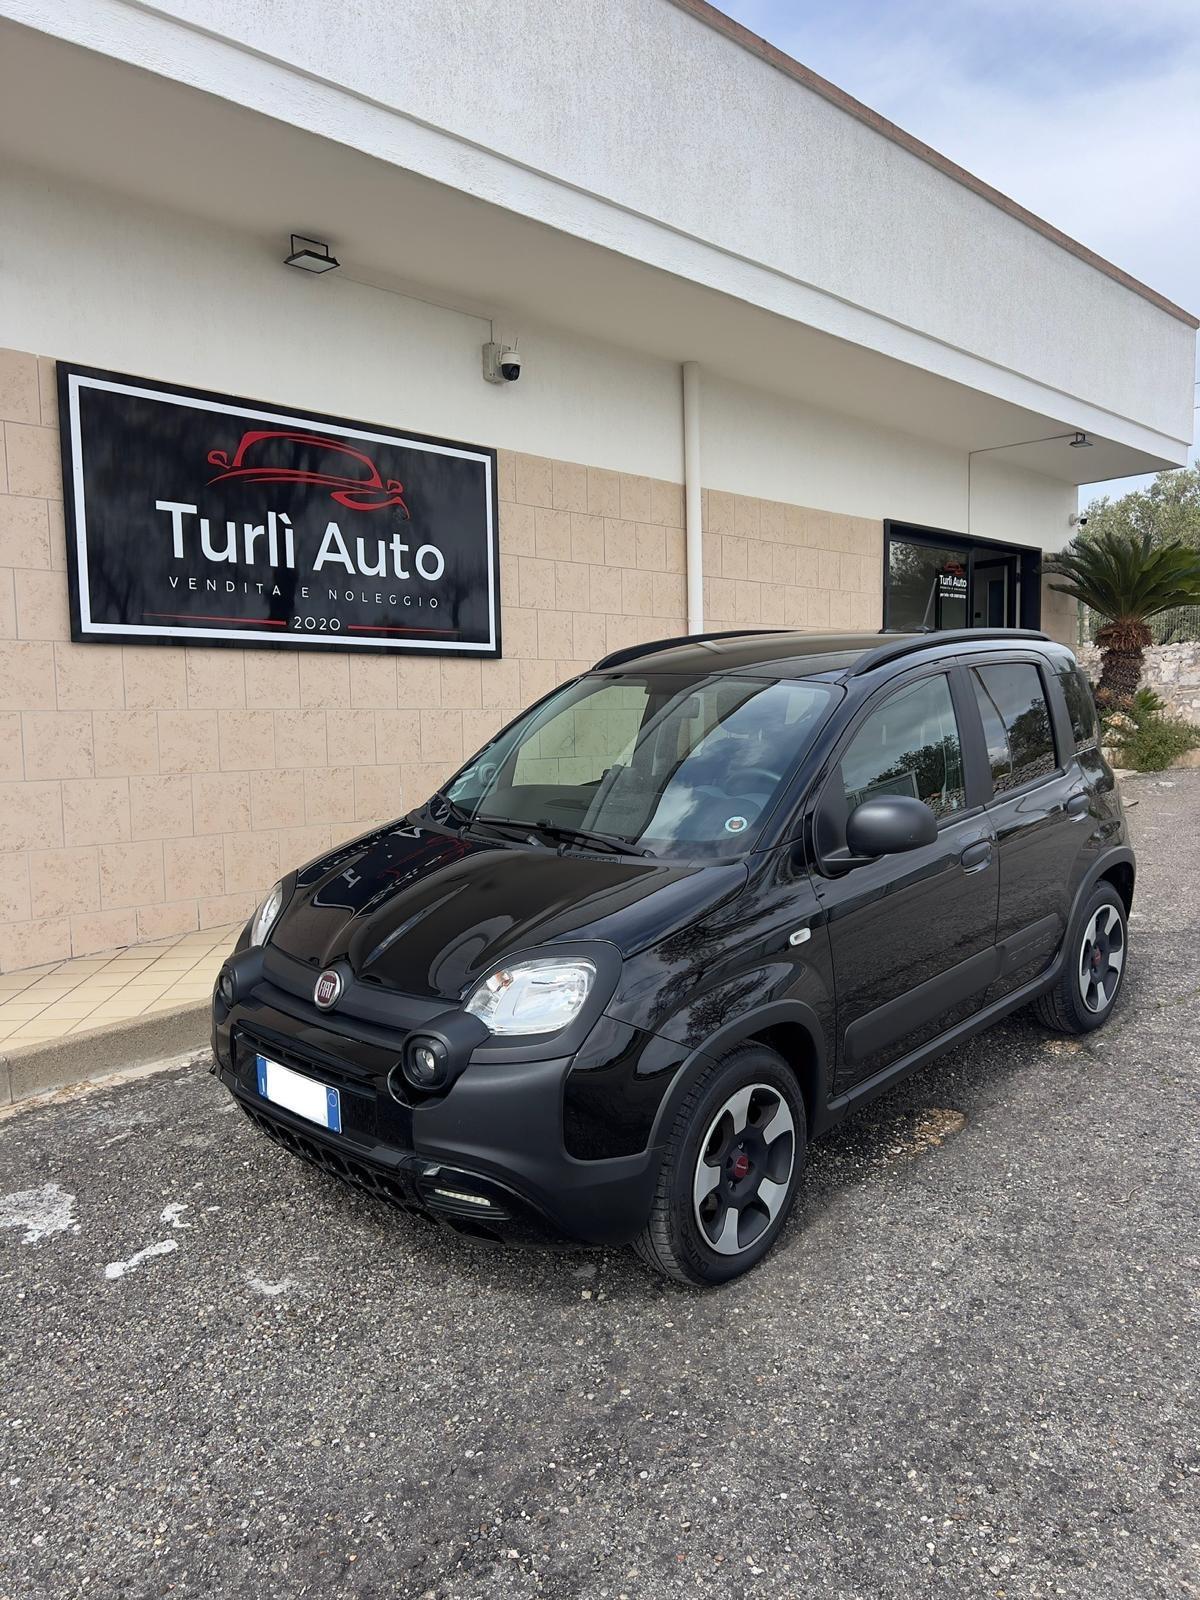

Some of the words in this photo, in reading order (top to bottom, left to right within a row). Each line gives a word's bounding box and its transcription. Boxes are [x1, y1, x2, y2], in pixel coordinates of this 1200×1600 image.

[155, 500, 295, 568] Turlì
[312, 522, 445, 581] Auto
[168, 576, 281, 596] VENDITA
[301, 587, 309, 598] E
[328, 589, 438, 608] NOLEGGIO
[294, 616, 341, 631] 2020
[318, 979, 336, 999] FIAT
